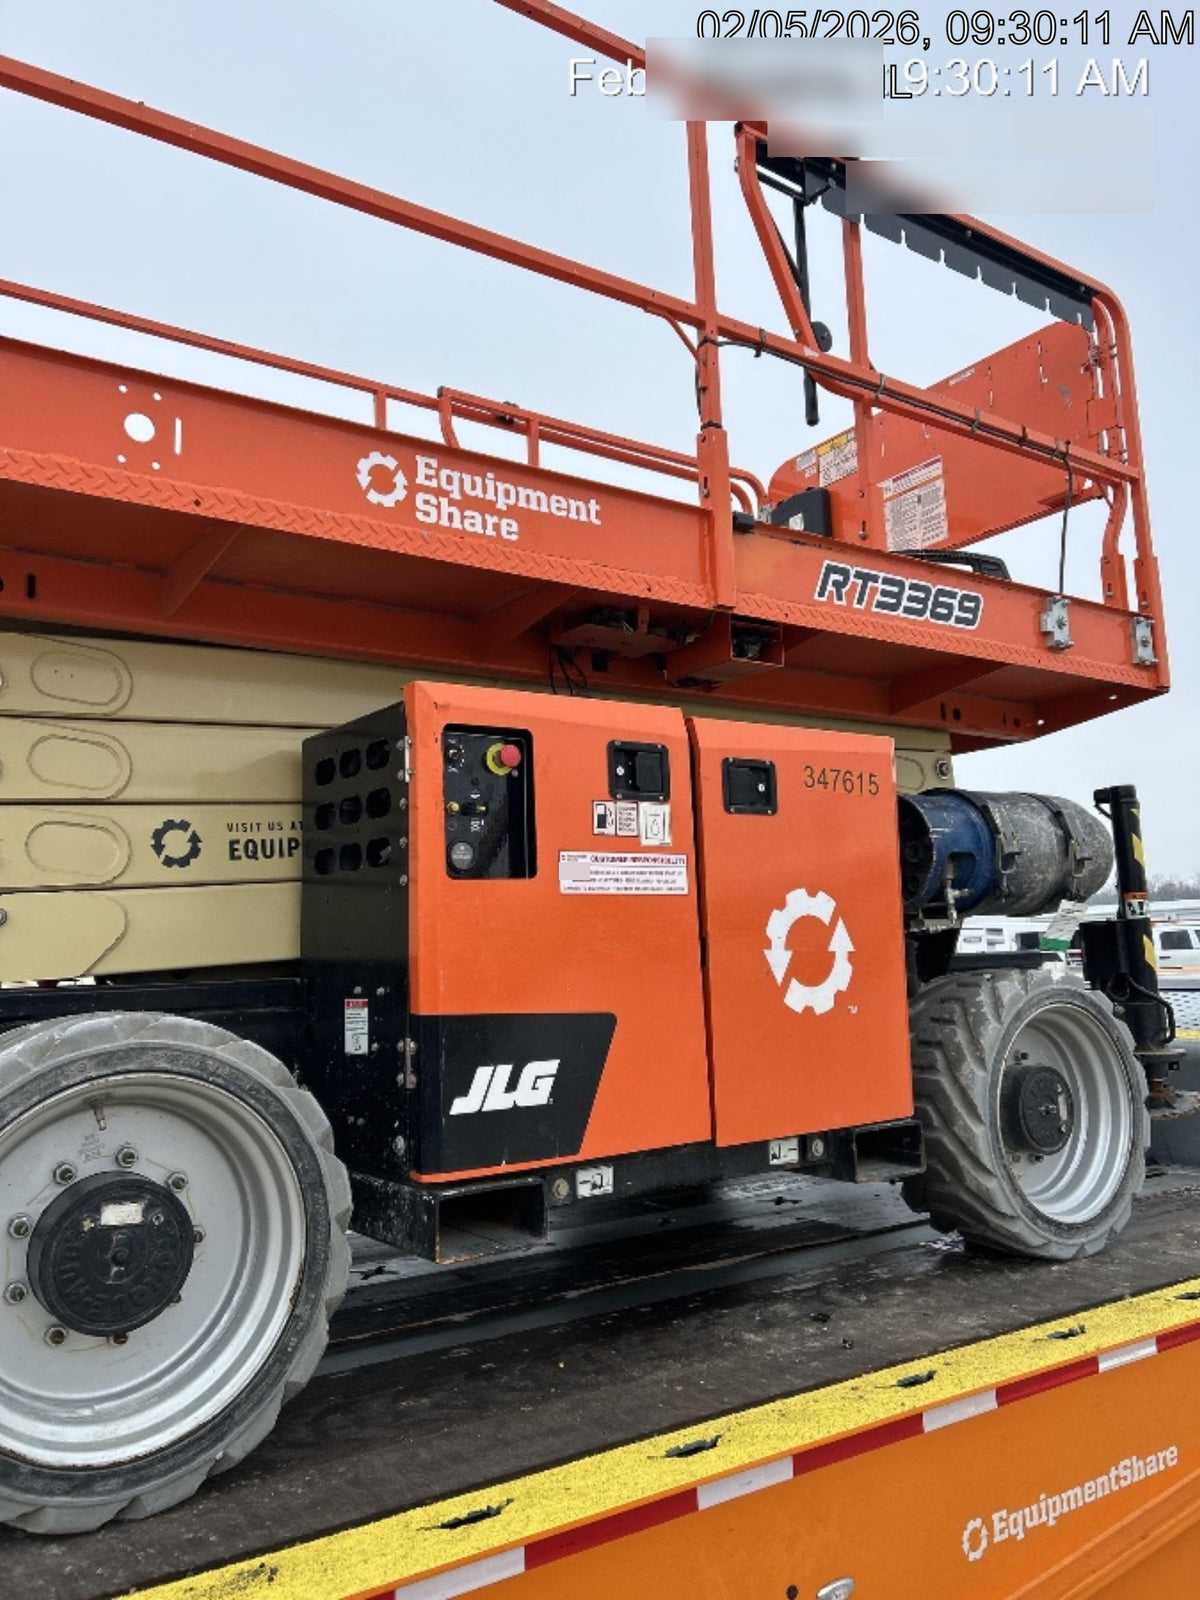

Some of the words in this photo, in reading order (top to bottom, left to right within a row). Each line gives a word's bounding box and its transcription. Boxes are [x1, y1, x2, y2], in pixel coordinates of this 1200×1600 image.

[415, 454, 602, 525] Equipment
[415, 493, 519, 541] Share
[814, 559, 984, 630] RT3369
[803, 765, 879, 796] 347615
[227, 822, 261, 832] VISIT
[267, 821, 283, 831] US
[290, 820, 303, 831] AT
[449, 1059, 560, 1115] JLG
[992, 1445, 1178, 1543] EquipmentShare
